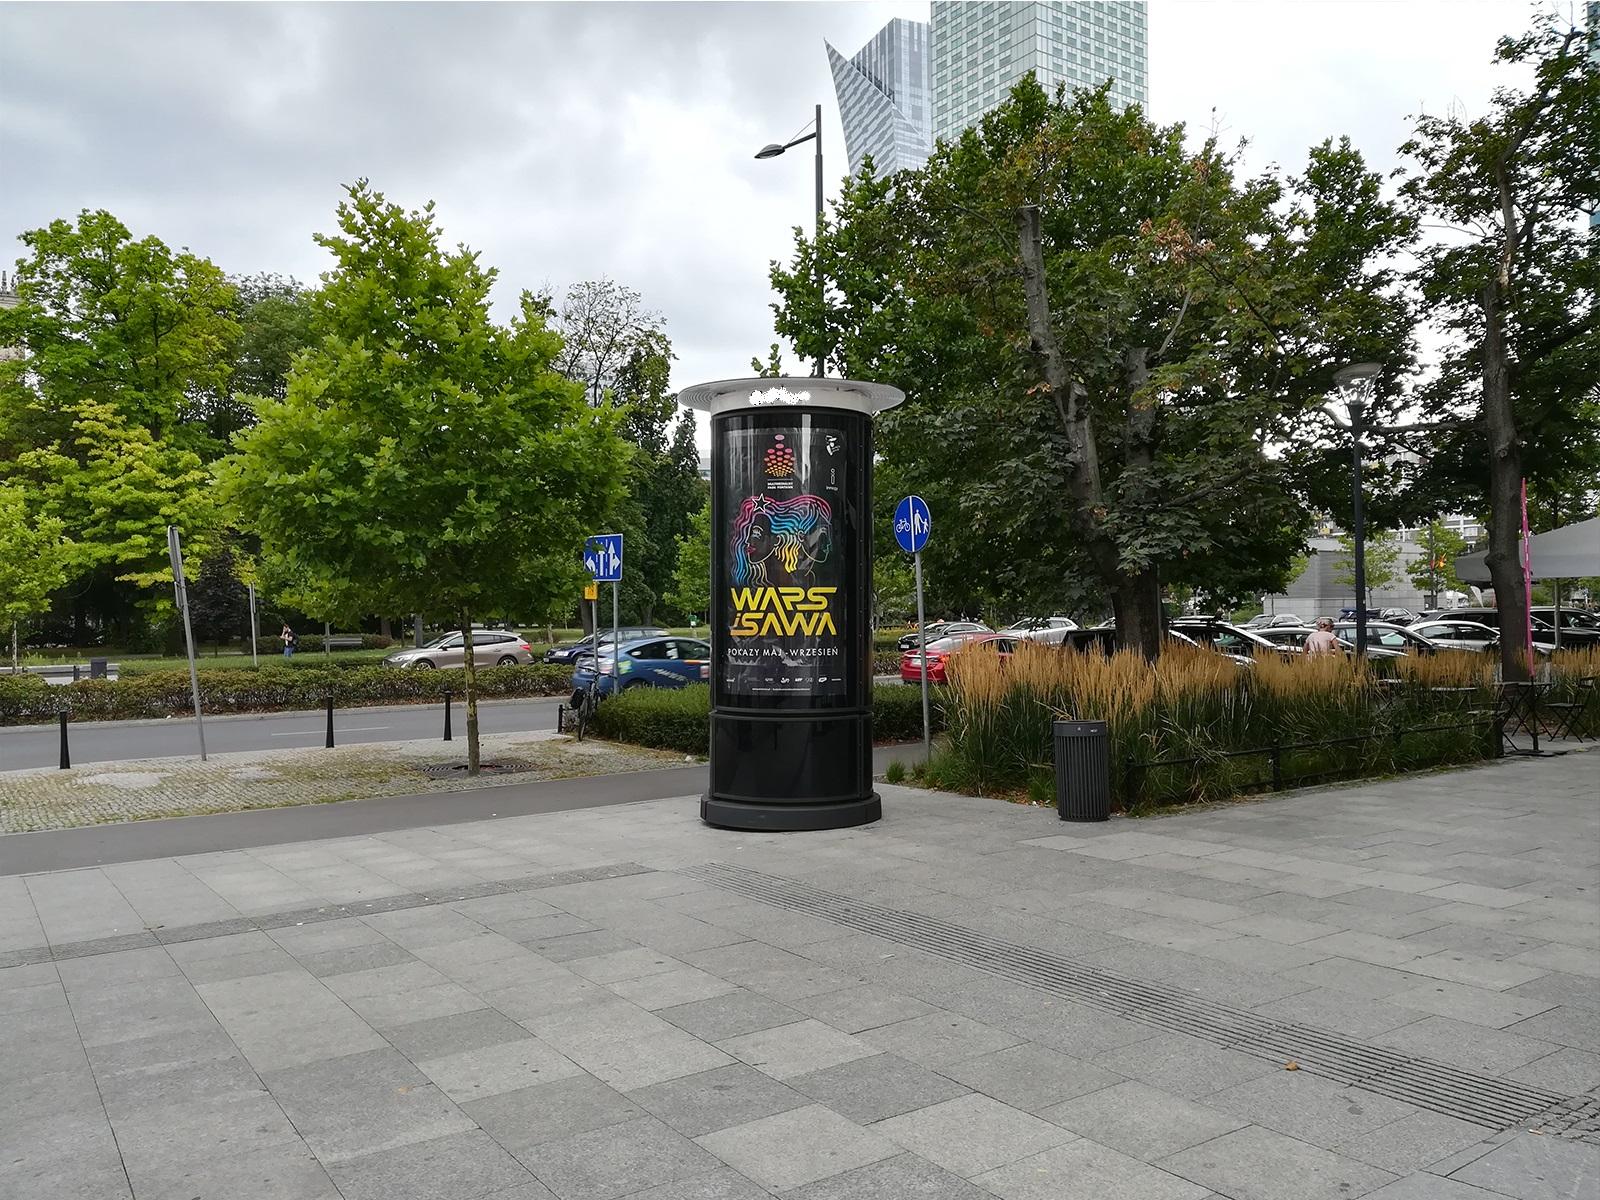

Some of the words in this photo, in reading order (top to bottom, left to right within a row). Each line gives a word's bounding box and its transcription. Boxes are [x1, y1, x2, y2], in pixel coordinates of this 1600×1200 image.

[730, 586, 838, 611] WARS
[728, 648, 760, 657] POKAZY
[762, 648, 782, 657] MAJ
[790, 646, 838, 657] WRZESIEŃ
